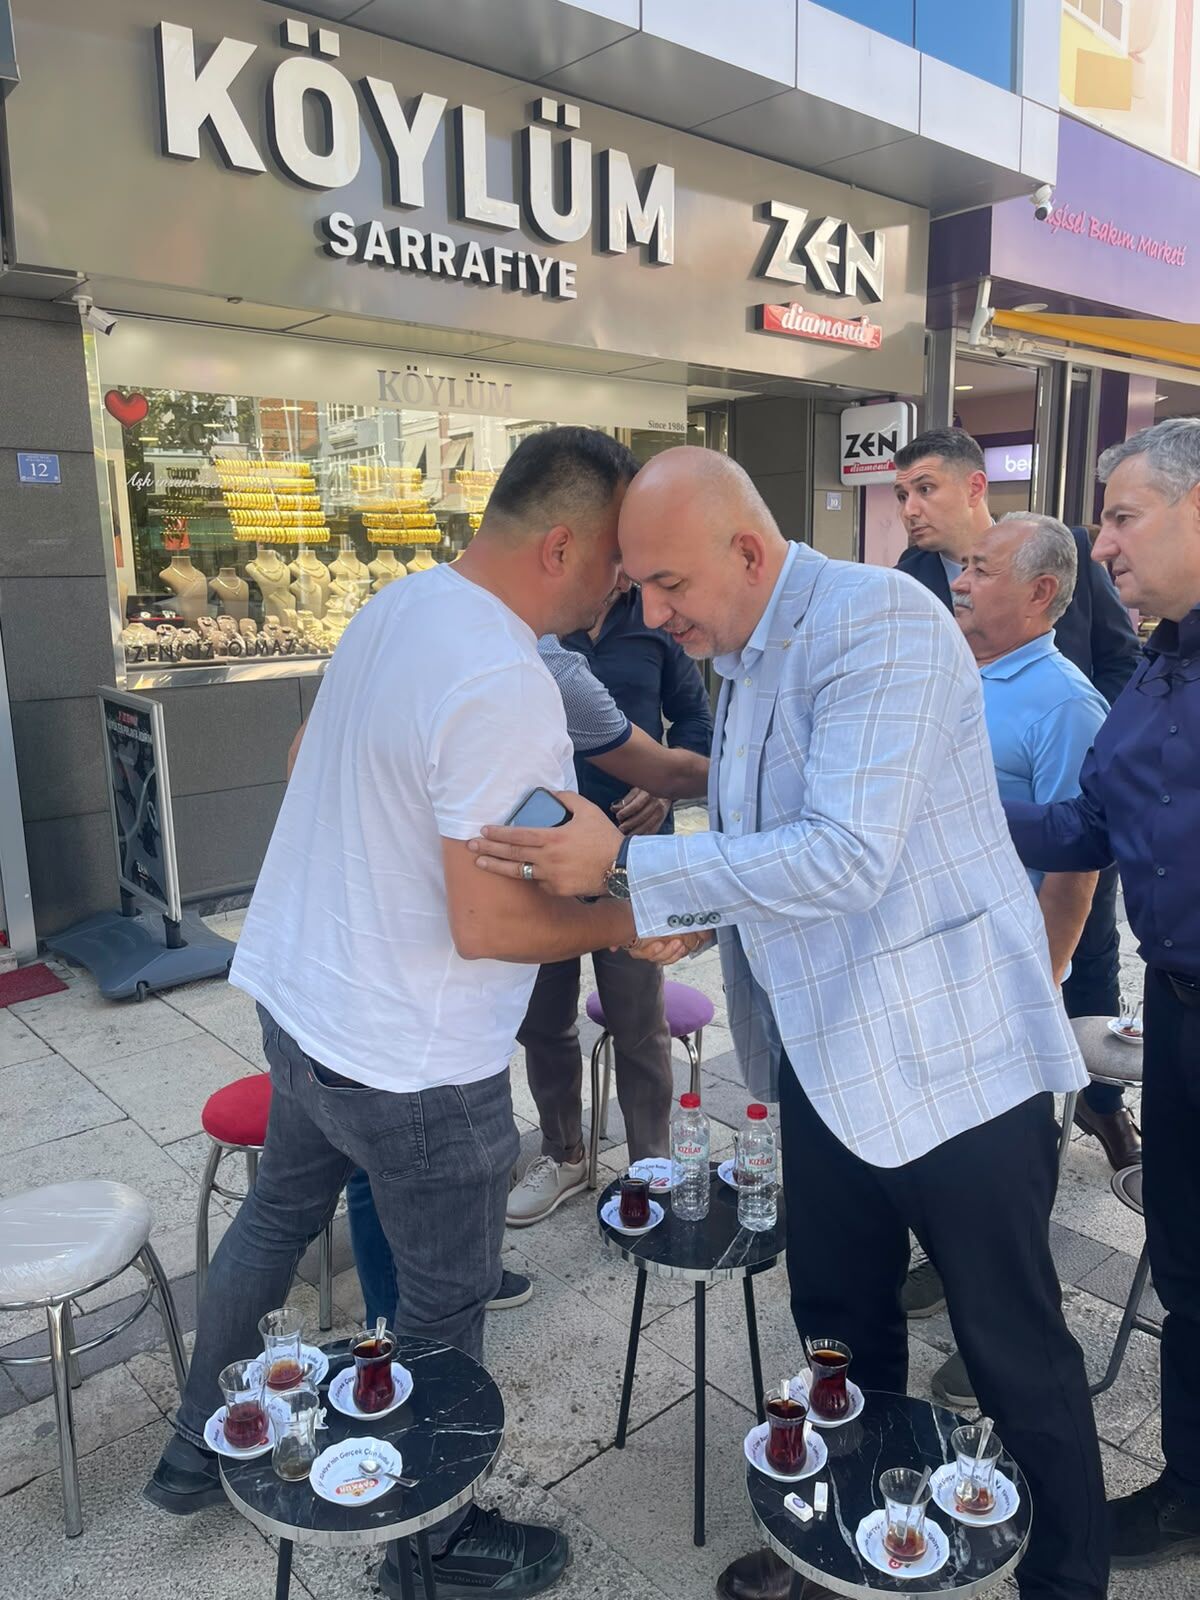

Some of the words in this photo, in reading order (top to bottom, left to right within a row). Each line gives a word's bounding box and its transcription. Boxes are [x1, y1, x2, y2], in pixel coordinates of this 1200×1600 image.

[158, 18, 675, 267] KÖYLÜM
[1042, 199, 1086, 234] işisel
[757, 200, 886, 302] ZEN
[780, 302, 869, 344] diamond
[377, 365, 512, 413] KÖYLÜM
[648, 420, 666, 430] Since
[668, 422, 685, 432] 1986
[843, 430, 899, 459] ZEN
[31, 463, 49, 477] 12
[849, 459, 891, 474] diamond
